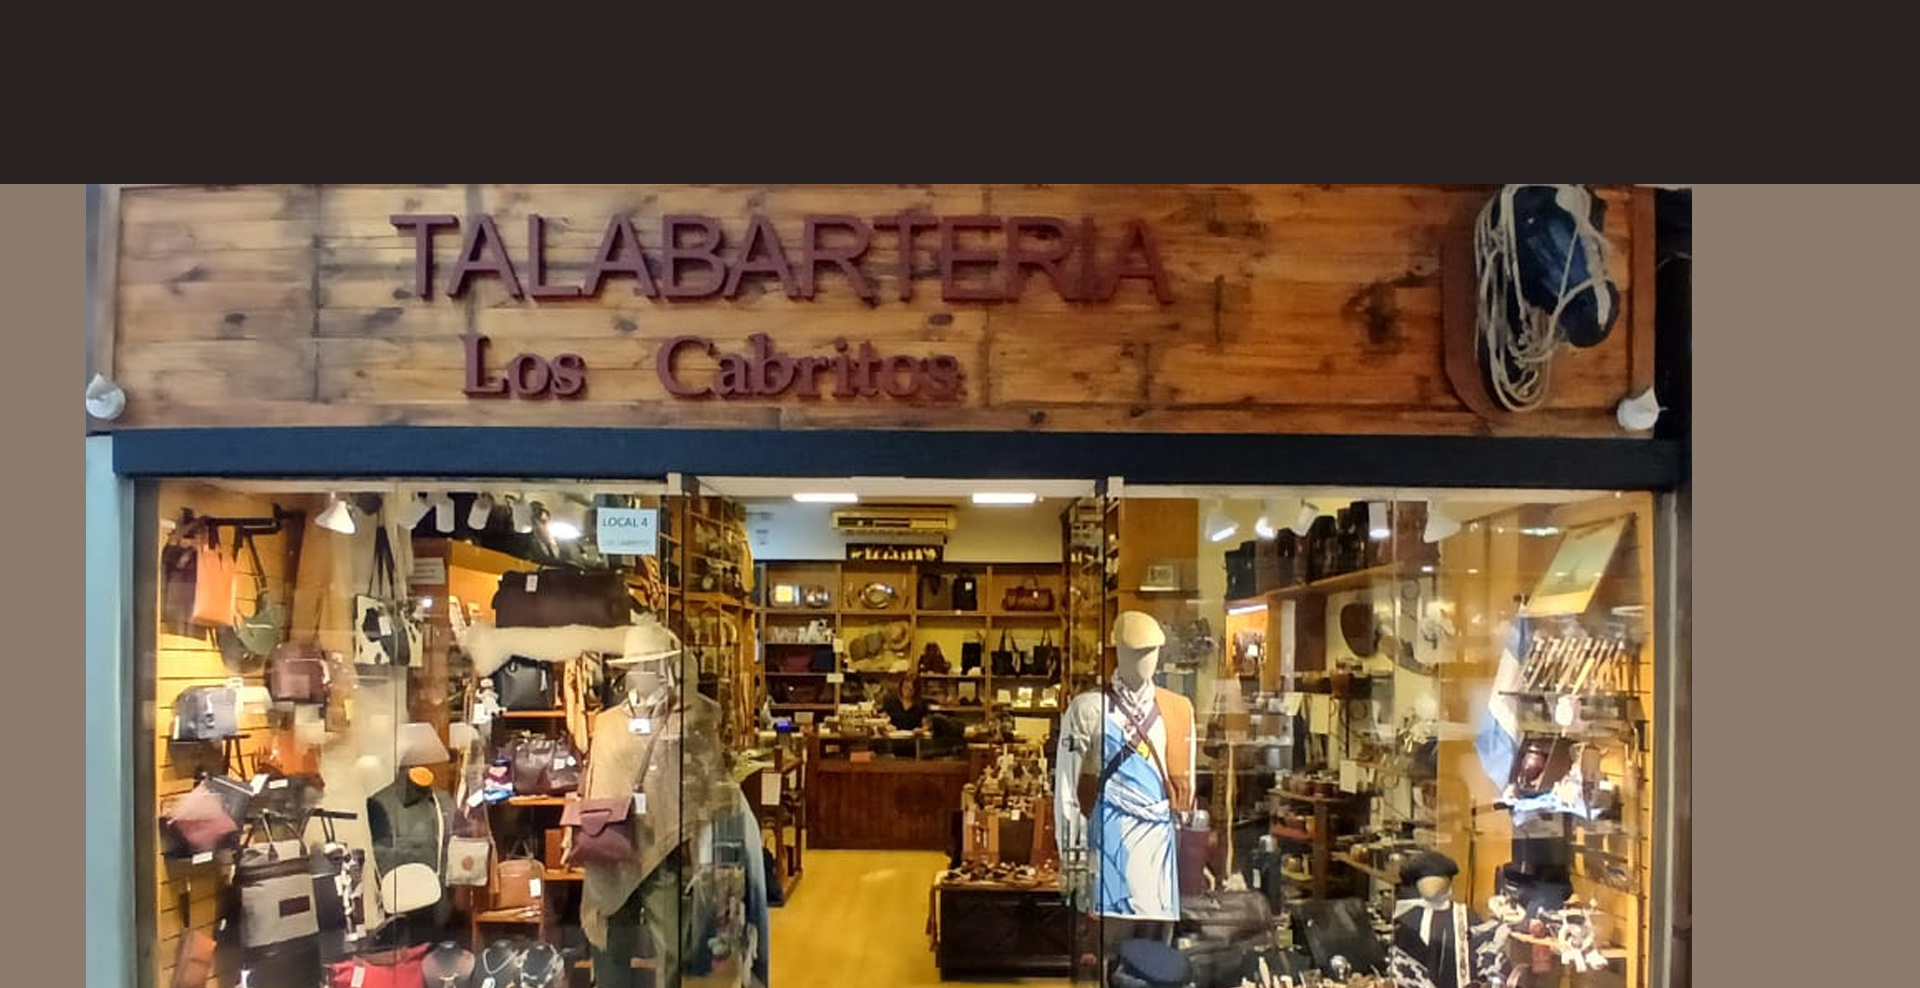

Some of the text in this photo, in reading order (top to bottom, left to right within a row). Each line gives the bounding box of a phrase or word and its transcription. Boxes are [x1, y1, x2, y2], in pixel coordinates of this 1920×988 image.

[390, 213, 1175, 305] TALABARTERIA
[460, 333, 962, 401] Los Cabritos
[602, 516, 648, 528] LOCAL 4
